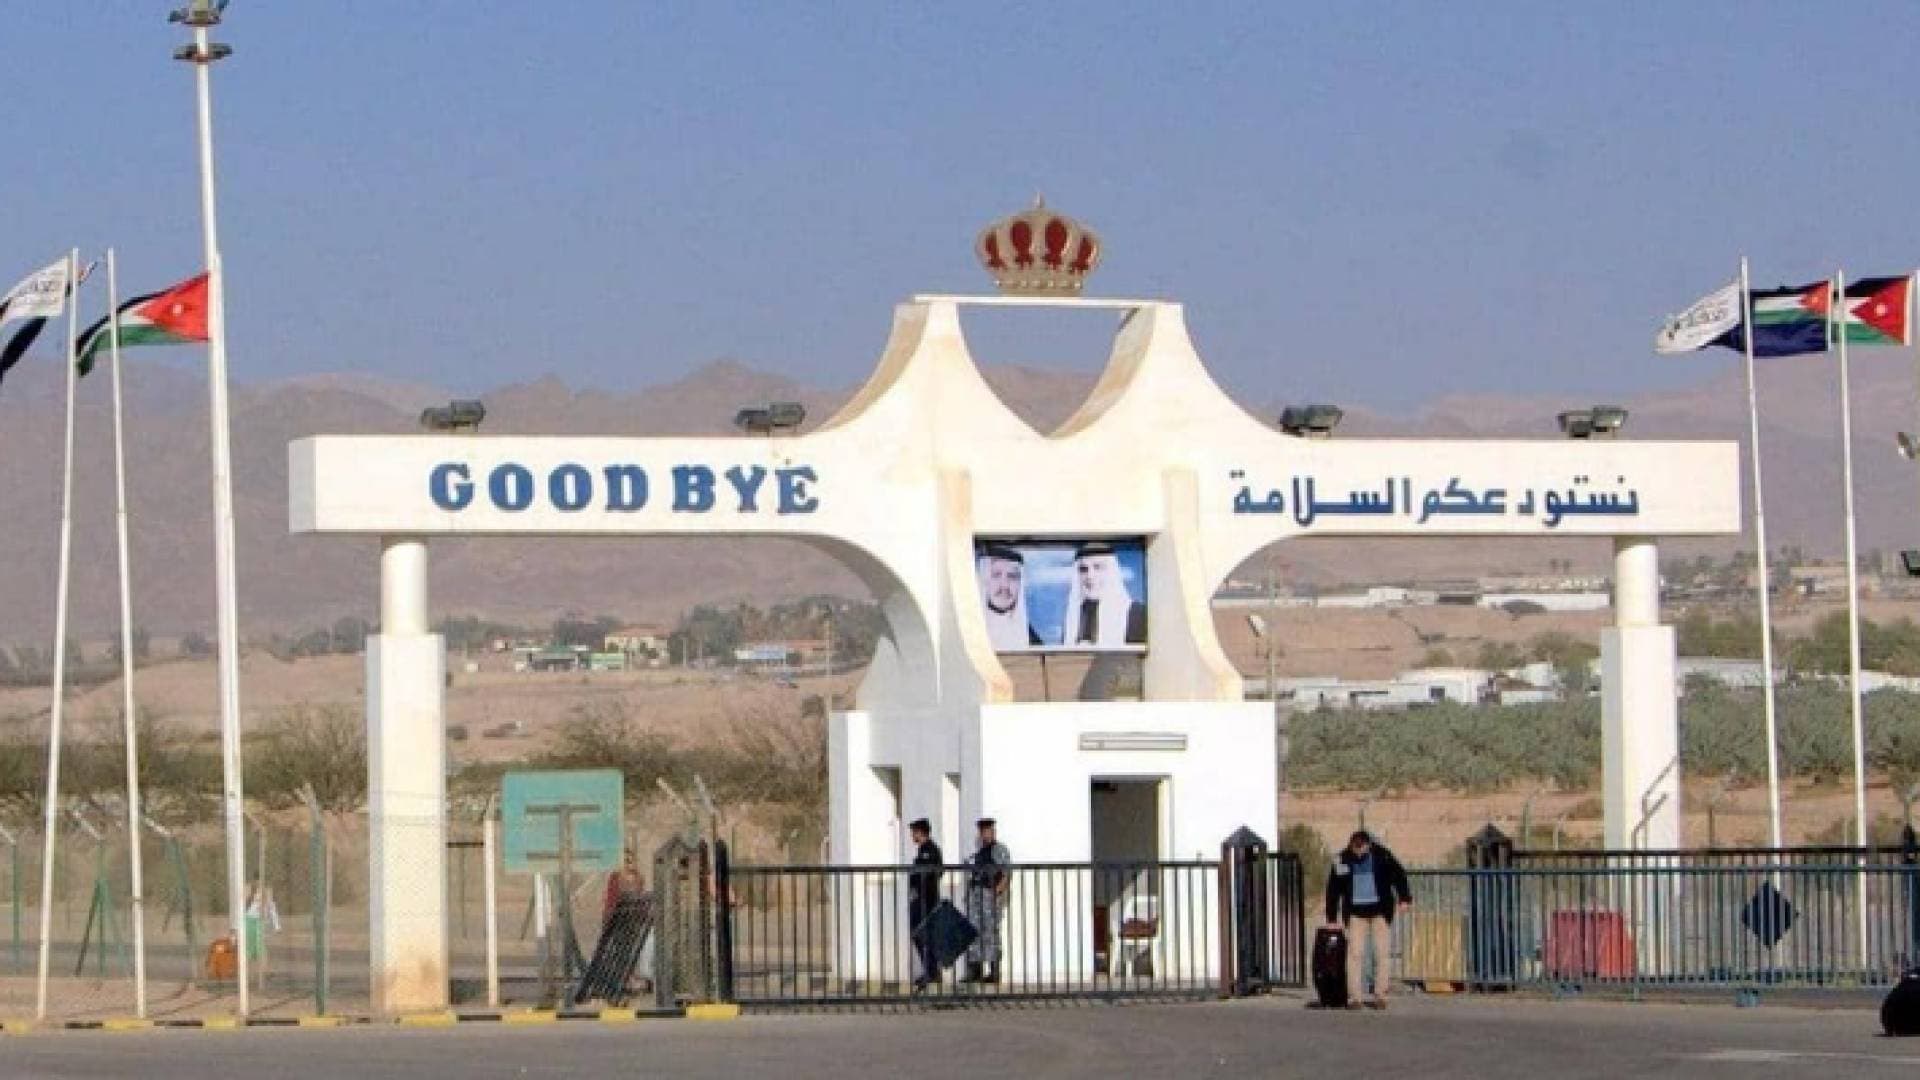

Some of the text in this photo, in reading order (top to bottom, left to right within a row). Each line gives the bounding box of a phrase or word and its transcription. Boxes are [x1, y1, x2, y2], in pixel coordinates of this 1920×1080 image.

[429, 462, 818, 515] GOOD BYE
[1230, 470, 1411, 527] السلامة
